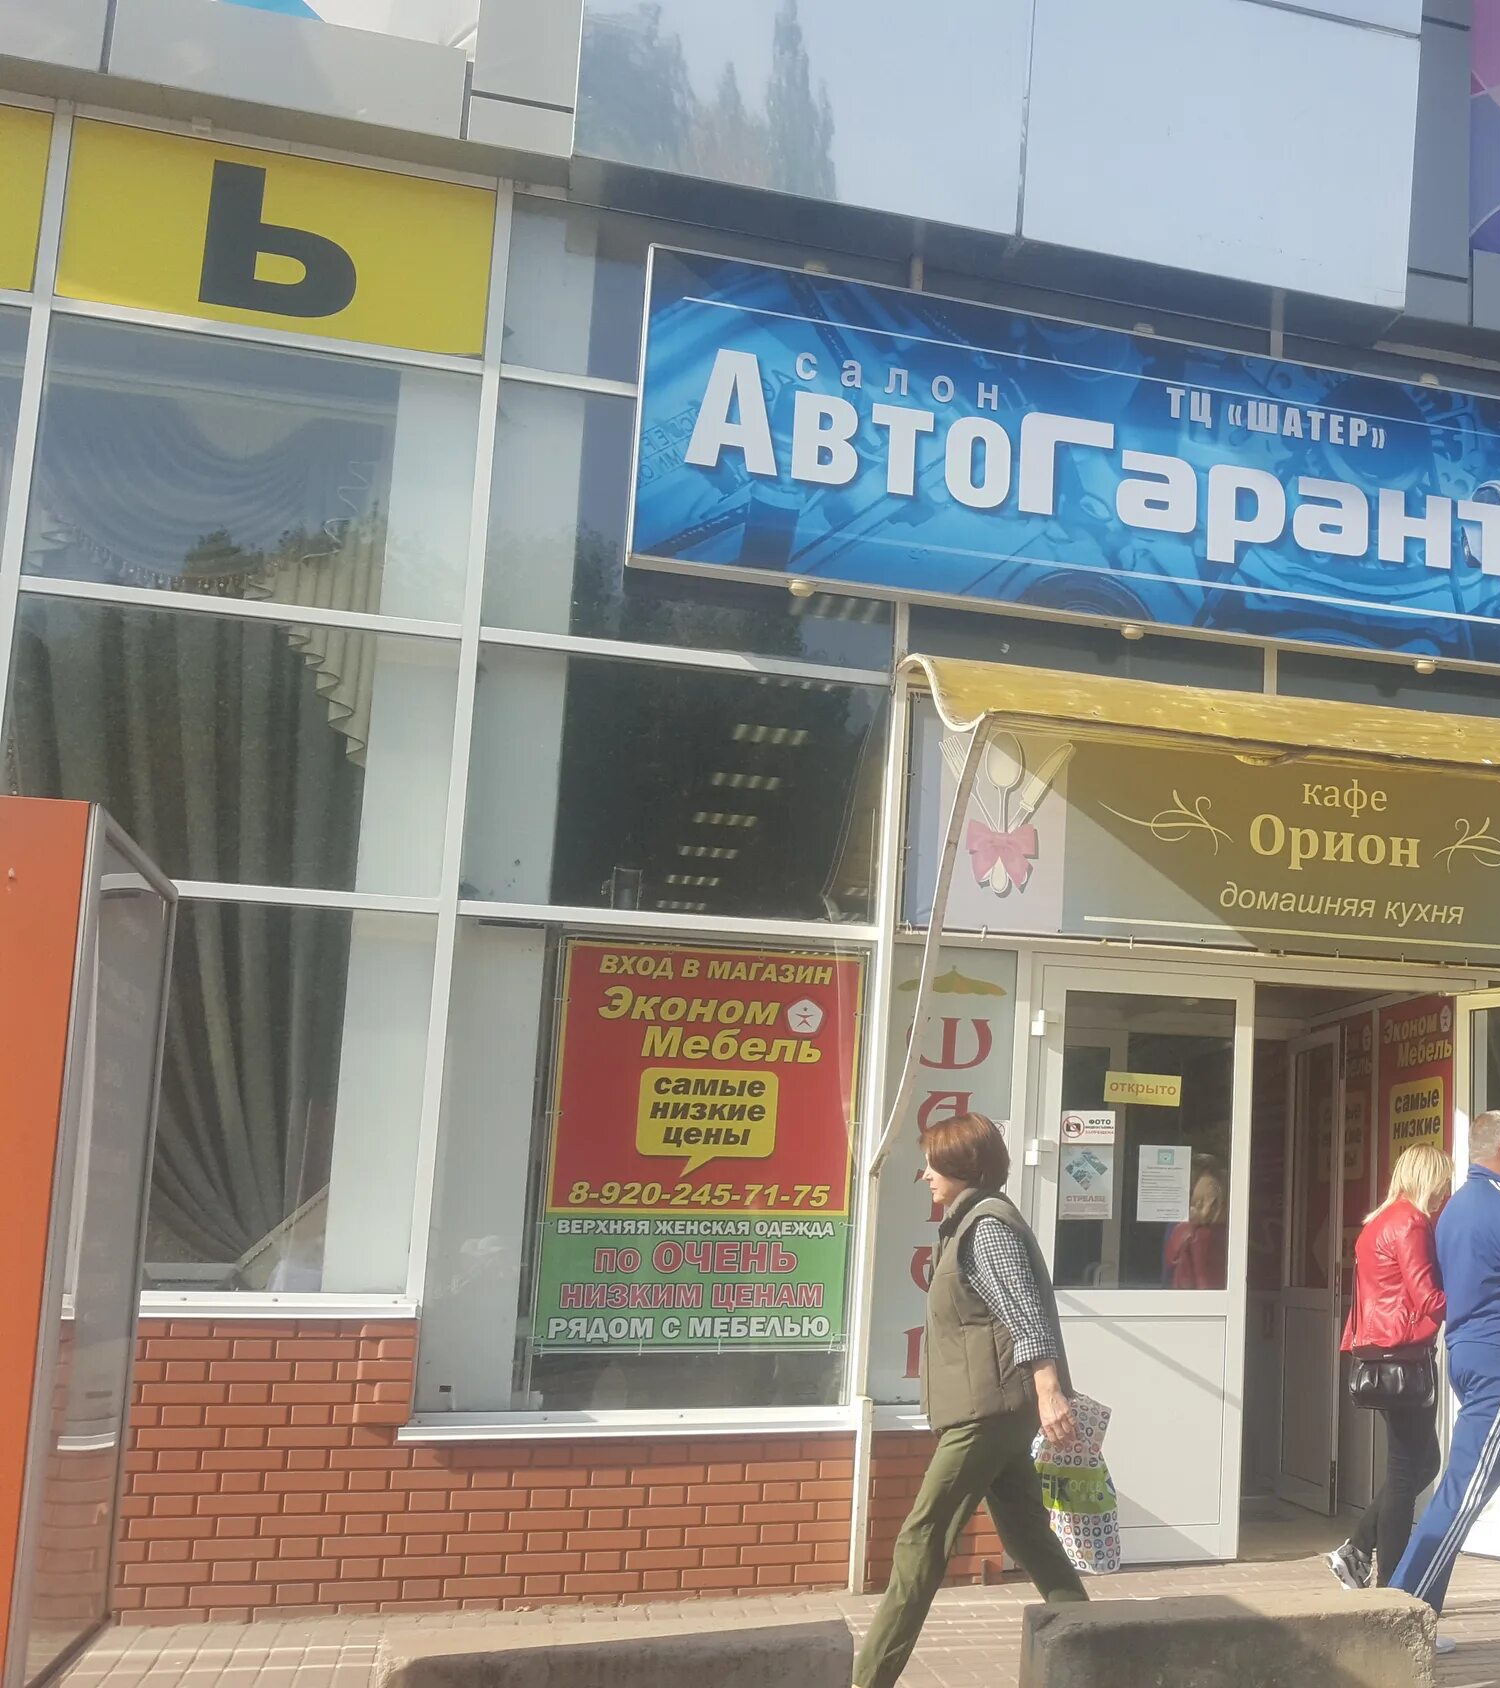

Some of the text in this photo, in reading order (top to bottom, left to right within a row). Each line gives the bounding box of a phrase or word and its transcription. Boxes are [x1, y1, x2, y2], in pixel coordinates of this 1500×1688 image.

[795, 352, 999, 411] салон
[1165, 386, 1388, 451] ТЦ «ШАТЕР»
[1301, 779, 1388, 817] кафе
[1249, 814, 1421, 871] Орион
[1219, 881, 1465, 926] домашняя кухня
[599, 953, 833, 985] ВХОД В МАГАЗИН
[598, 985, 780, 1026] Эконом
[641, 1025, 822, 1063] Мебель
[1383, 1013, 1438, 1045] Эконом
[1398, 1038, 1453, 1068] Мебель
[653, 1076, 766, 1098] самые
[1109, 1082, 1177, 1097] открыто
[1394, 1088, 1440, 1114] самые
[650, 1101, 766, 1122] низкие
[662, 1126, 751, 1147] цены
[1393, 1116, 1441, 1140] низкие
[568, 1181, 831, 1207] 8-920-245-71-75
[557, 1219, 834, 1238] ВЕРХНЯЯ ЖЕНСКАЯ ОДЕЖДА
[652, 1240, 798, 1274] ОЧЕНЬ
[559, 1283, 823, 1312] НИЗКИМ ЦЕНАМ
[548, 1316, 830, 1343] РЯДОМ С МЕБЕЛЬЮ
